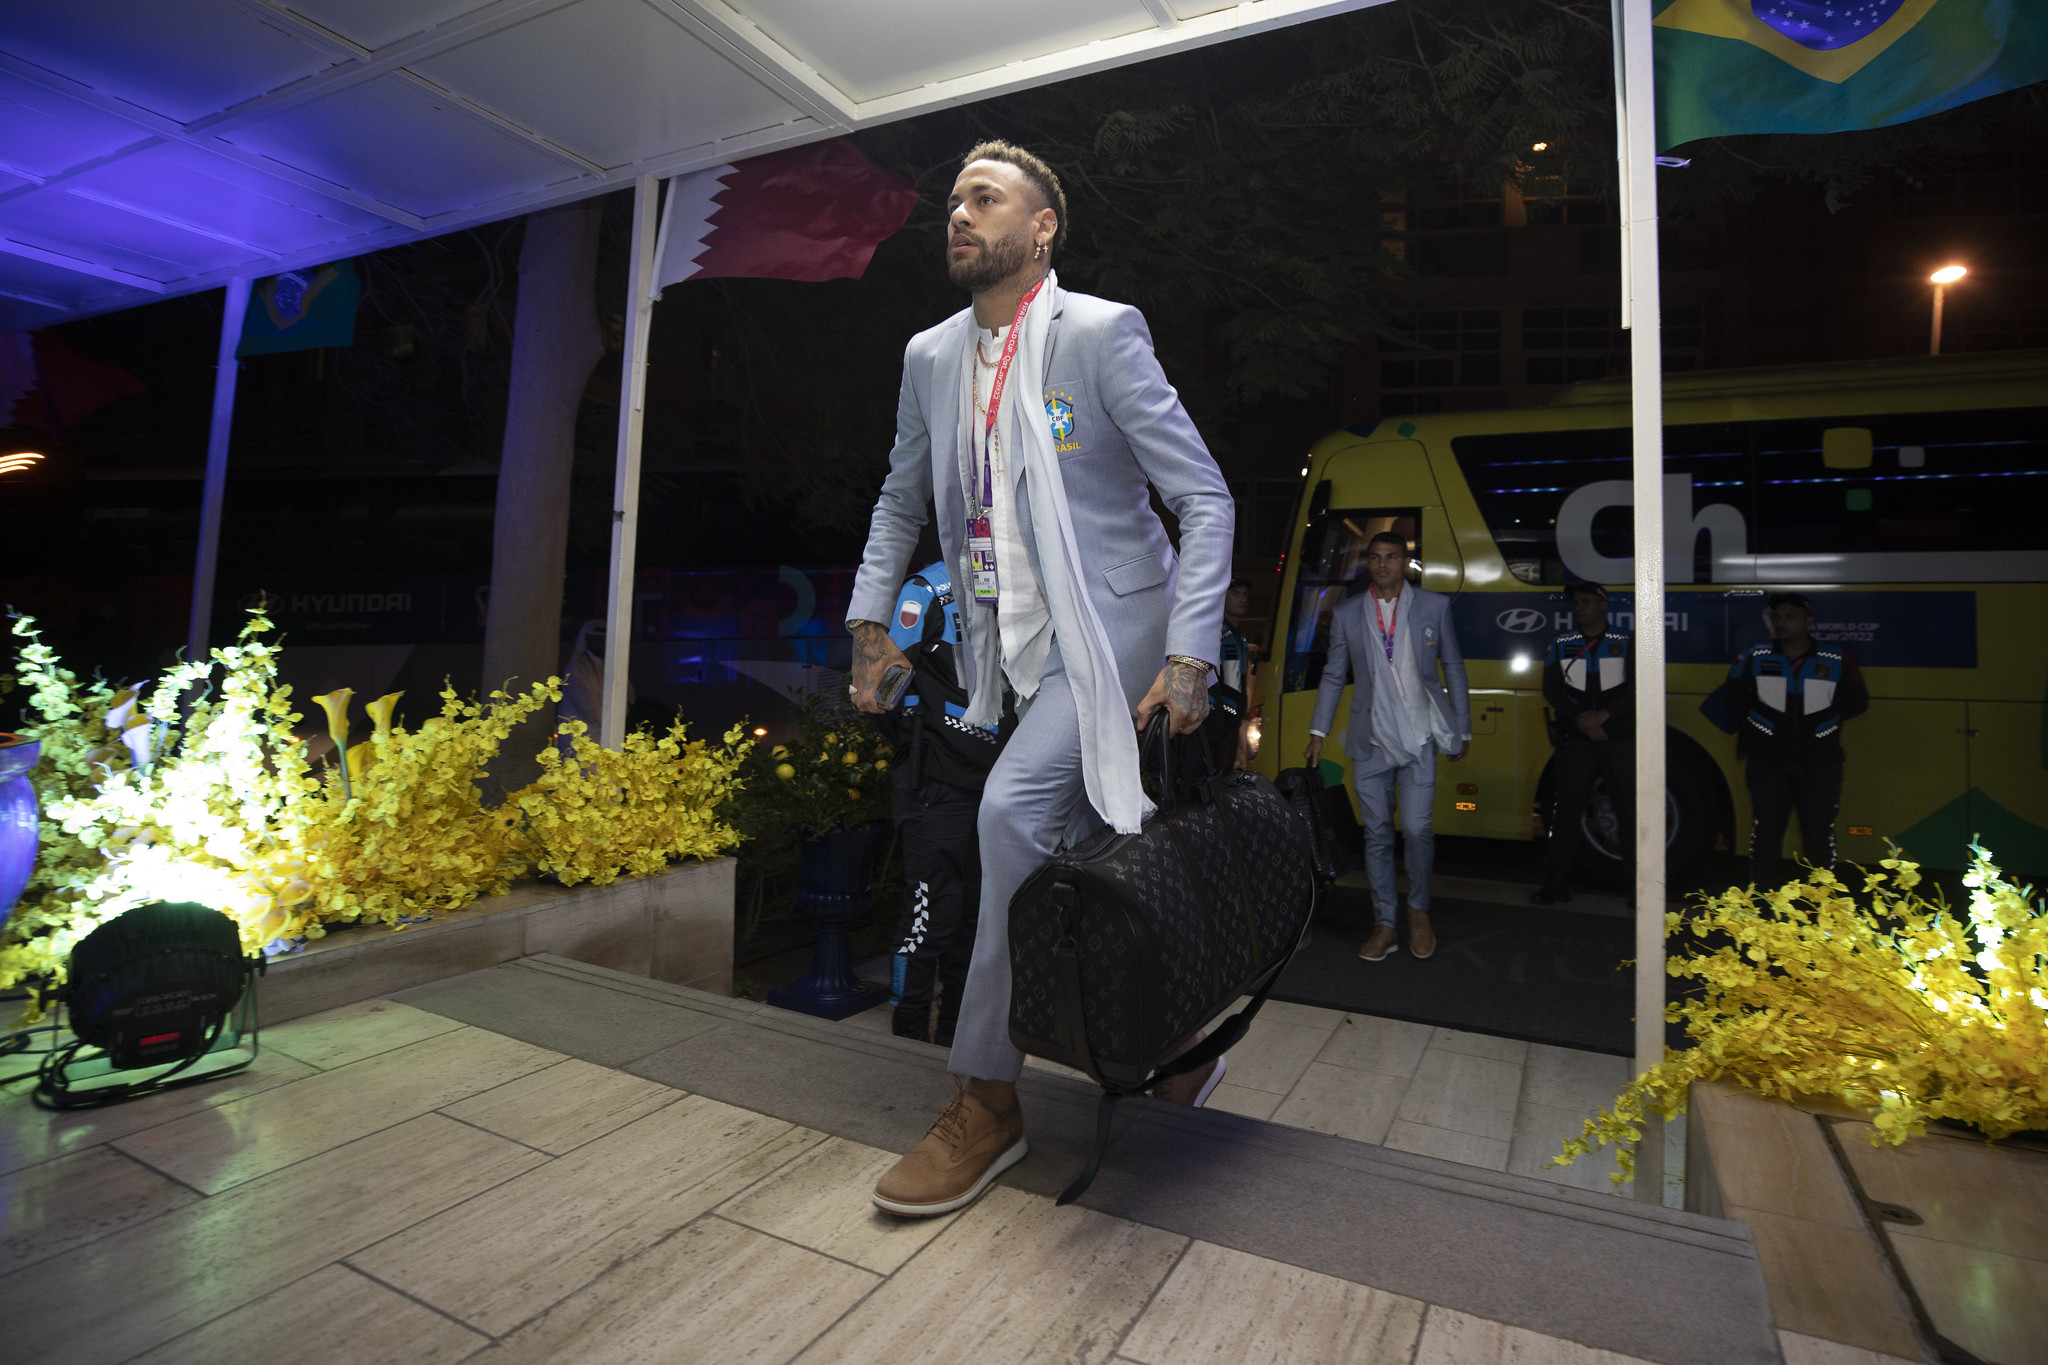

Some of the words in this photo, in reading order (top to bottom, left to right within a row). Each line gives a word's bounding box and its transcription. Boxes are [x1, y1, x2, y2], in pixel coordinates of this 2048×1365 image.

[1019, 301, 1029, 317] FIFA
[1011, 316, 1025, 340] WORLD
[1007, 338, 1016, 353] CUP
[1055, 441, 1082, 453] RASIL
[291, 593, 412, 613] HYUNDAI
[1554, 611, 1688, 632] HNAI
[1816, 622, 1857, 631] WORLD
[1858, 622, 1880, 631] CUP
[1810, 632, 1875, 641] tar2022
